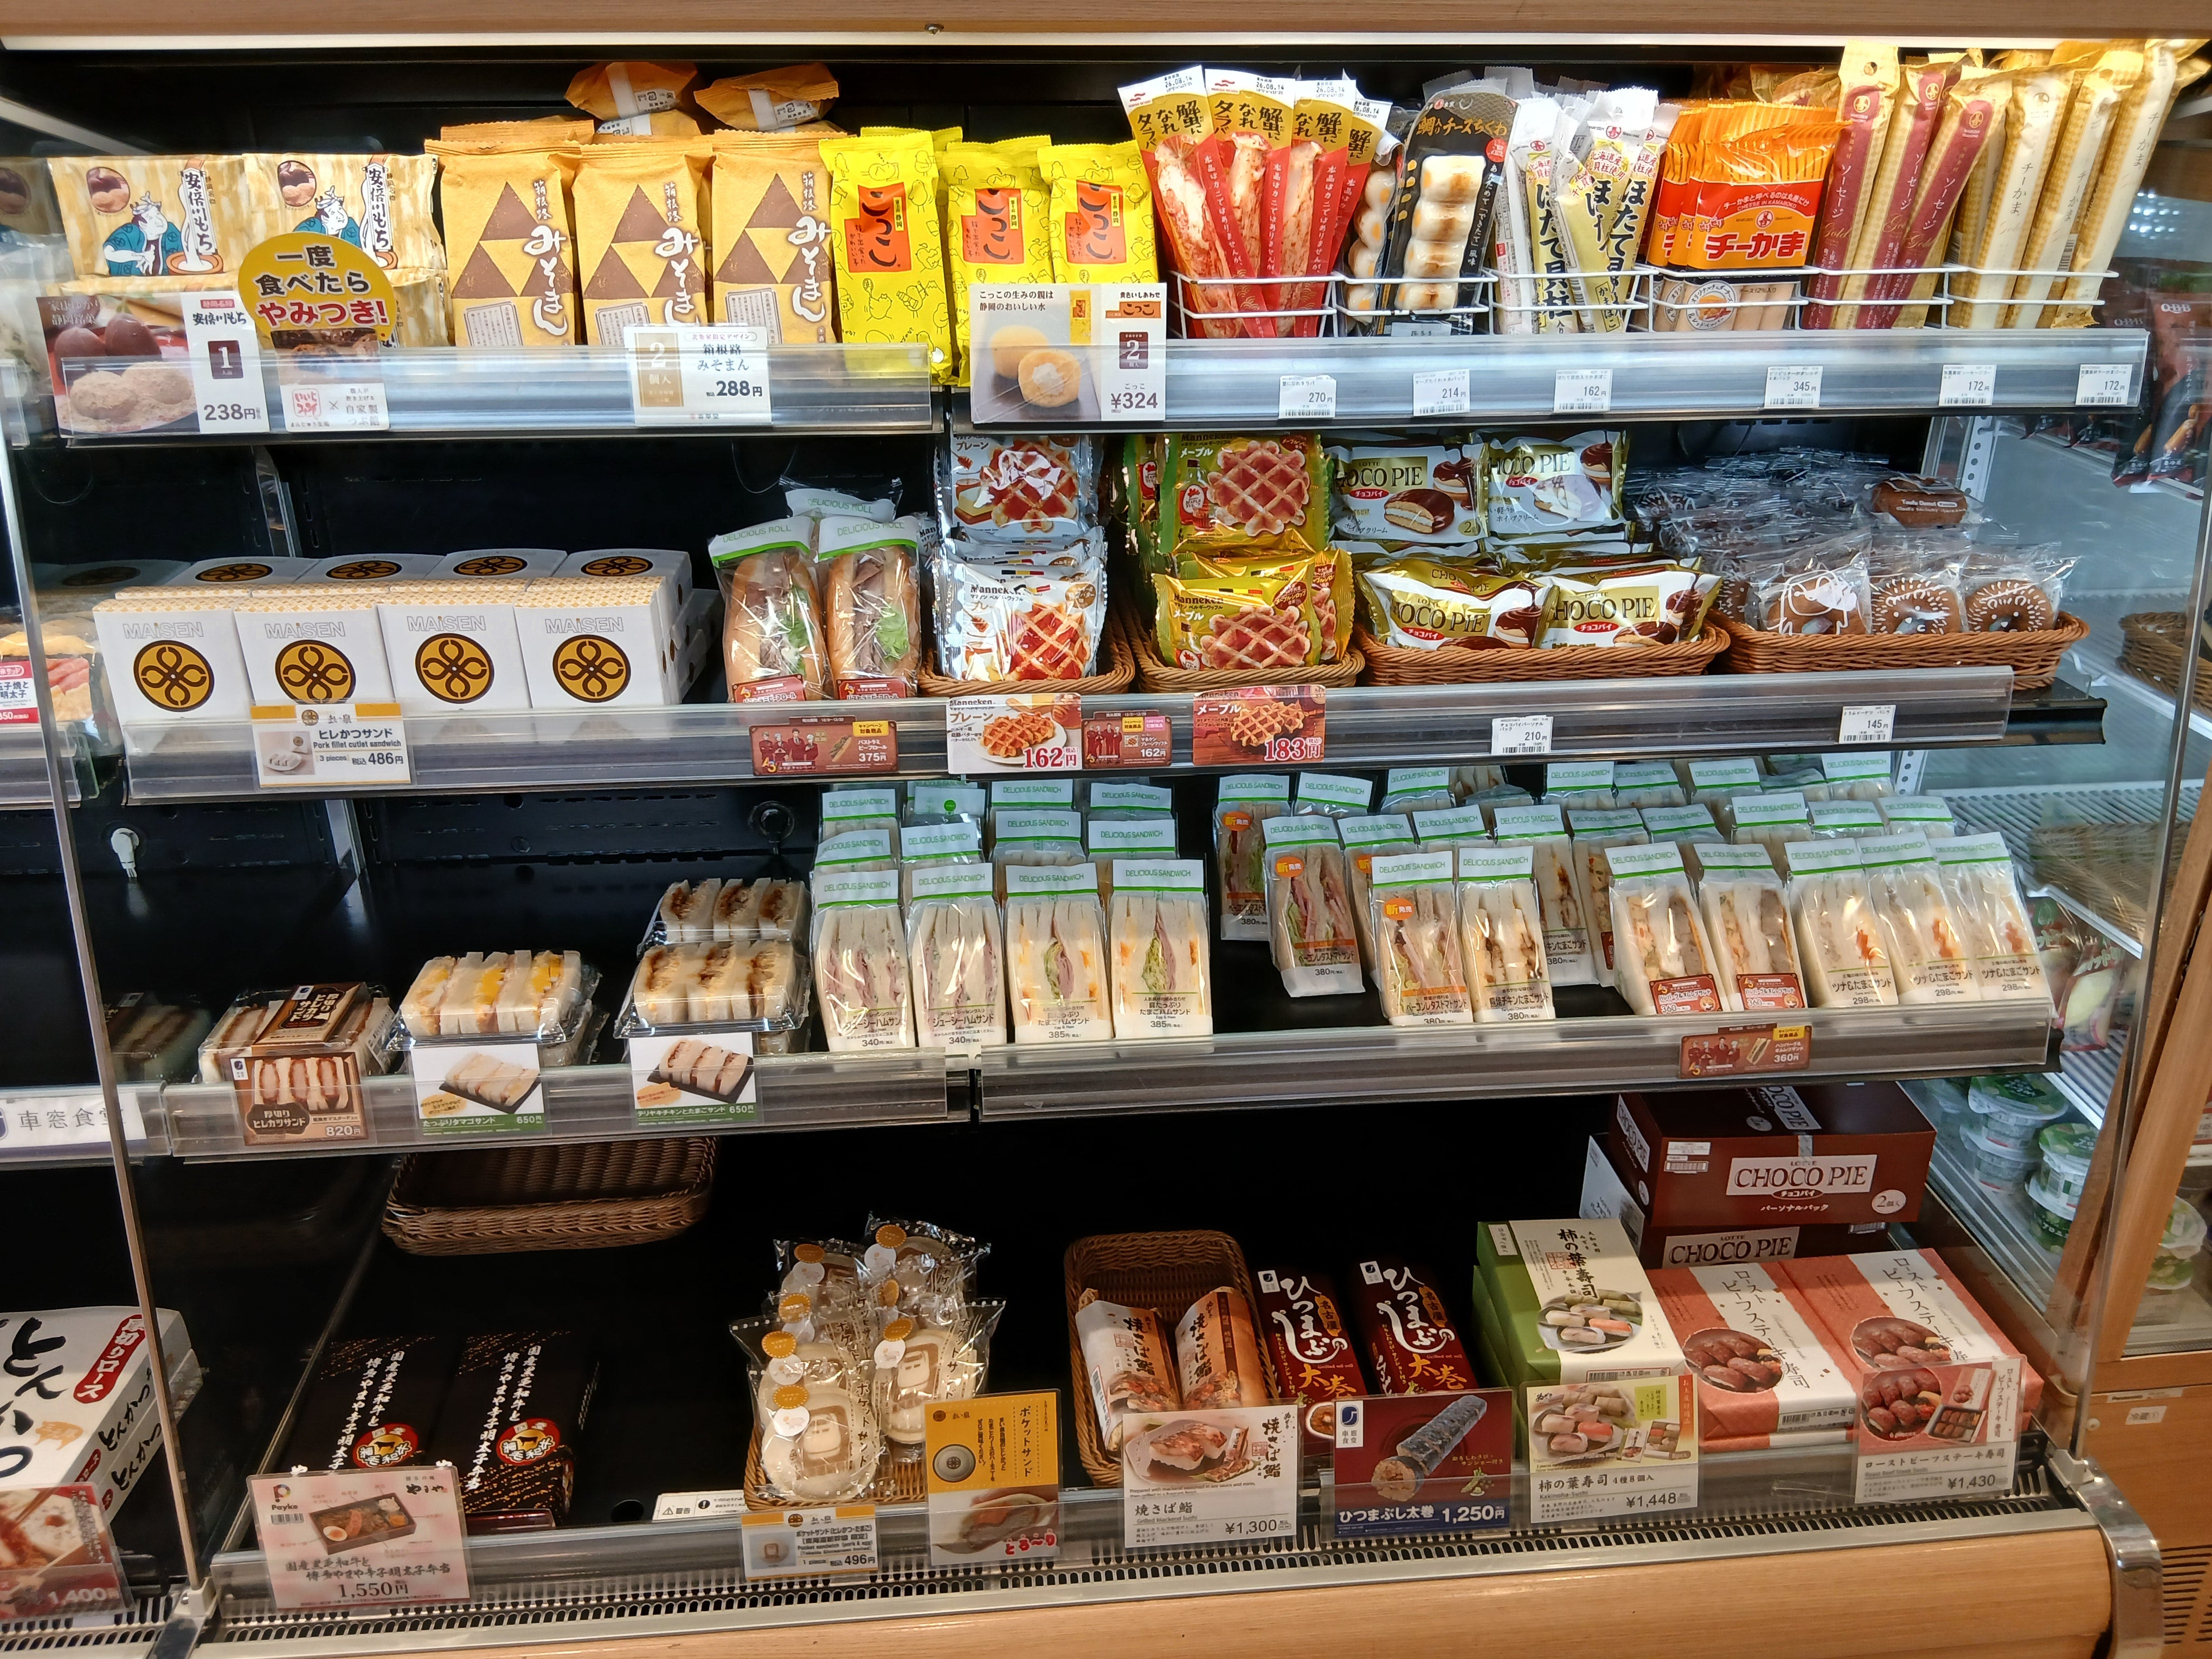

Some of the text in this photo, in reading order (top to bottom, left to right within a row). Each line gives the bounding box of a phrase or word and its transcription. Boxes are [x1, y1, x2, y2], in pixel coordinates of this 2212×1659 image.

[1155, 108, 1180, 134] なれ
[1214, 99, 1234, 134] タラバ
[1238, 102, 1257, 129] なれ
[1137, 113, 1157, 150] タラバ
[1294, 112, 1314, 137] なれ
[1900, 153, 1924, 210] ソーセージ
[2010, 163, 2034, 215] チーかま
[802, 171, 818, 212] 箱根路
[1832, 164, 1852, 218] ソーセージ
[534, 179, 552, 220] 箱根路
[664, 176, 683, 223] 箱根路
[1923, 178, 1956, 230] ソーセージ
[185, 172, 213, 252] 安倍川もち
[370, 168, 389, 248] 安倍川もち
[1705, 232, 1806, 260] チーかま
[277, 245, 336, 267] 一度
[655, 227, 699, 324] みそまん
[788, 216, 831, 321] みそまん
[255, 271, 370, 297] 食べたら
[524, 225, 568, 336] みそまん
[979, 291, 1054, 301] こっこの生みの親は
[1119, 292, 1161, 300] 黄色いしあわせ
[979, 304, 1046, 314] 静岡のおいしい水
[1123, 304, 1155, 317] こっこ
[192, 312, 247, 326] 安倍川もち
[703, 344, 741, 356] 箱根路
[1126, 340, 1140, 361] 2
[697, 358, 749, 371] みそまん
[716, 381, 763, 397] 288円
[1442, 387, 1466, 399] 214円
[1584, 385, 1606, 396] 162円
[1793, 381, 1816, 392] 345円
[1969, 381, 1990, 391] 172円
[2105, 380, 2125, 391] 172円
[1110, 392, 1159, 409] ¥324
[1309, 392, 1333, 403] 270円
[203, 403, 257, 421] 238円
[956, 440, 989, 452] プレーン
[1181, 446, 1214, 458] メープル
[1336, 466, 1423, 488] HOCO PIE
[808, 499, 850, 512] DELICIOUS
[723, 525, 792, 543] DELICIOUS ROLL
[1174, 609, 1205, 621] メープル
[1407, 628, 1439, 639] チョコパイ
[1579, 623, 1612, 632] チョコパイ
[1198, 703, 1242, 716] メープル
[950, 712, 994, 724] プレーン
[1867, 719, 1888, 729] 145円
[319, 728, 393, 740] ヒレかつサンド
[1525, 731, 1547, 741] 210円
[313, 742, 330, 751] Pork
[369, 741, 402, 749] sandwich
[1140, 748, 1166, 758] 162円
[1264, 738, 1321, 761] 183円
[326, 755, 348, 763] pieces
[368, 753, 404, 765] 486円
[858, 752, 888, 762] 375円
[1024, 747, 1077, 768] 162円
[1003, 786, 1033, 794] DELICIOUS
[829, 800, 859, 808] DELICIOUS
[1008, 819, 1038, 827] DELICIOUS
[908, 833, 971, 845] DELICIOUS SANDWICH
[1101, 829, 1163, 839] DELICIOUS SANDWICH
[824, 880, 891, 892] DELICIOUS SANDWICH
[290, 1000, 311, 1022] サンド
[933, 1013, 994, 1027] ジューシーハムサンド
[1038, 1017, 1090, 1026] たまごハムサンド
[1774, 1053, 1799, 1063] 360円
[638, 1106, 726, 1117] テリヤキチキンとたまごサンド
[253, 1117, 306, 1128] ヒレカツサンド
[423, 1117, 496, 1127] たっぷりタマゴサンド
[326, 1126, 361, 1137] 820円
[1735, 1166, 1868, 1188] CHOCO PIE
[1780, 1189, 1816, 1198] チョコパイ
[1670, 1237, 1792, 1264] CHOCO PIE
[1557, 1228, 1598, 1299] 柿の葉寿司
[1894, 1257, 1928, 1293] ロースト
[1734, 1270, 1767, 1304] ロースト
[1723, 1280, 1810, 1390] ビーフステーキ寿司
[1123, 1316, 1156, 1377] 焼さば鮨
[1190, 1313, 1213, 1385] 焼さば鮨
[1409, 1353, 1468, 1390] 太巻
[508, 1345, 542, 1422] 国産黒毛和牛と
[1298, 1364, 1356, 1397] 太巻
[368, 1351, 405, 1427] 国産黒毛和牛と
[857, 1380, 871, 1469] ポケットサンド
[1019, 1405, 1032, 1478] ポケットサンド
[1262, 1416, 1281, 1479] 焼さば鮨
[1864, 1448, 2005, 1469] ローストビーフステーキ寿司
[1539, 1473, 1609, 1492] 柿の葉寿司
[1947, 1474, 1996, 1489] ¥1,430
[1134, 1501, 1193, 1516] 焼さば鮨
[1626, 1493, 1677, 1508] ¥1,448
[1339, 1506, 1435, 1523] ひつまぶし太巻
[1442, 1504, 1506, 1524] 1,250円
[1225, 1519, 1278, 1535] ¥1,300
[844, 1554, 876, 1566] 496円
[337, 1581, 409, 1599] 1,550円
